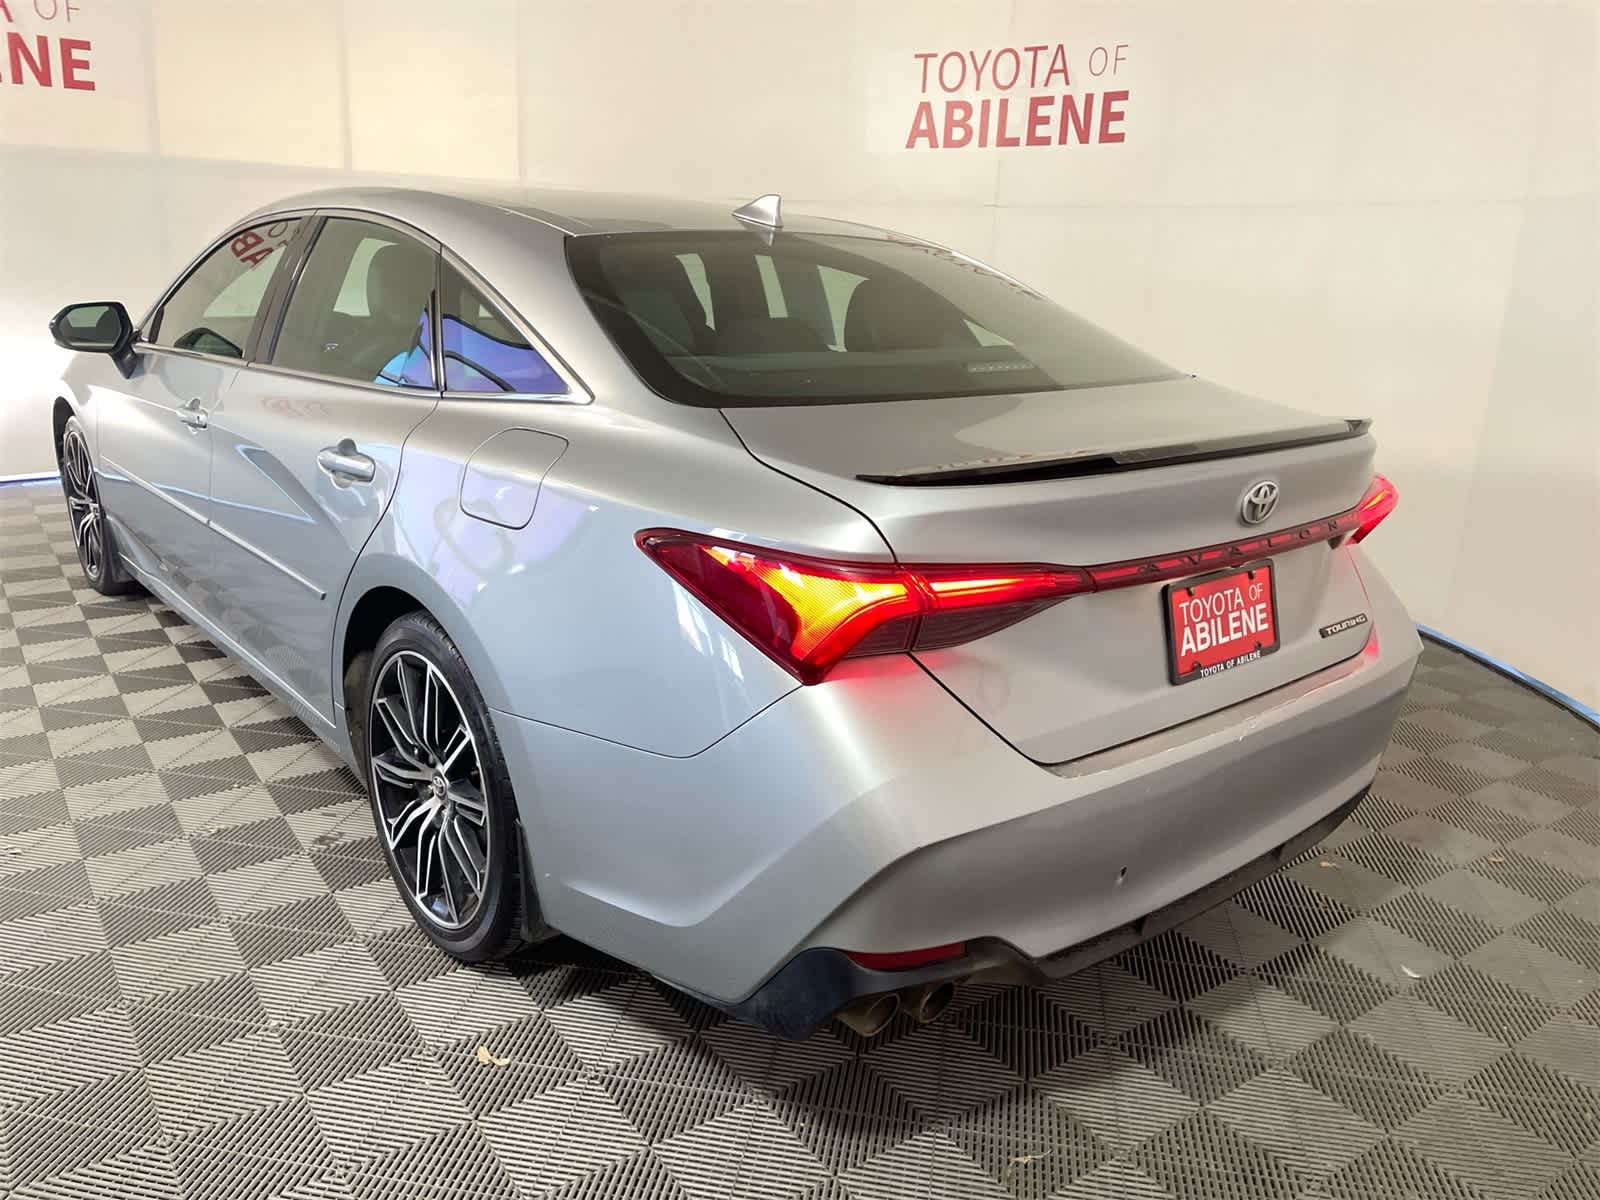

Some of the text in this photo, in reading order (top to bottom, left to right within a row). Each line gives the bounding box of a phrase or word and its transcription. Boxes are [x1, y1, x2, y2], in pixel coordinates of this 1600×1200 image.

[0, 32, 96, 91] NE
[914, 44, 1129, 93] TOYOTA OF
[905, 90, 1129, 149] ABILENE
[1137, 519, 1338, 573] AVALON
[1179, 582, 1264, 625] TOYOTA OF
[1325, 615, 1366, 635] TOURING
[1181, 602, 1269, 657] ABILENE
[1200, 650, 1261, 678] TOYOTA OF ABILENE
